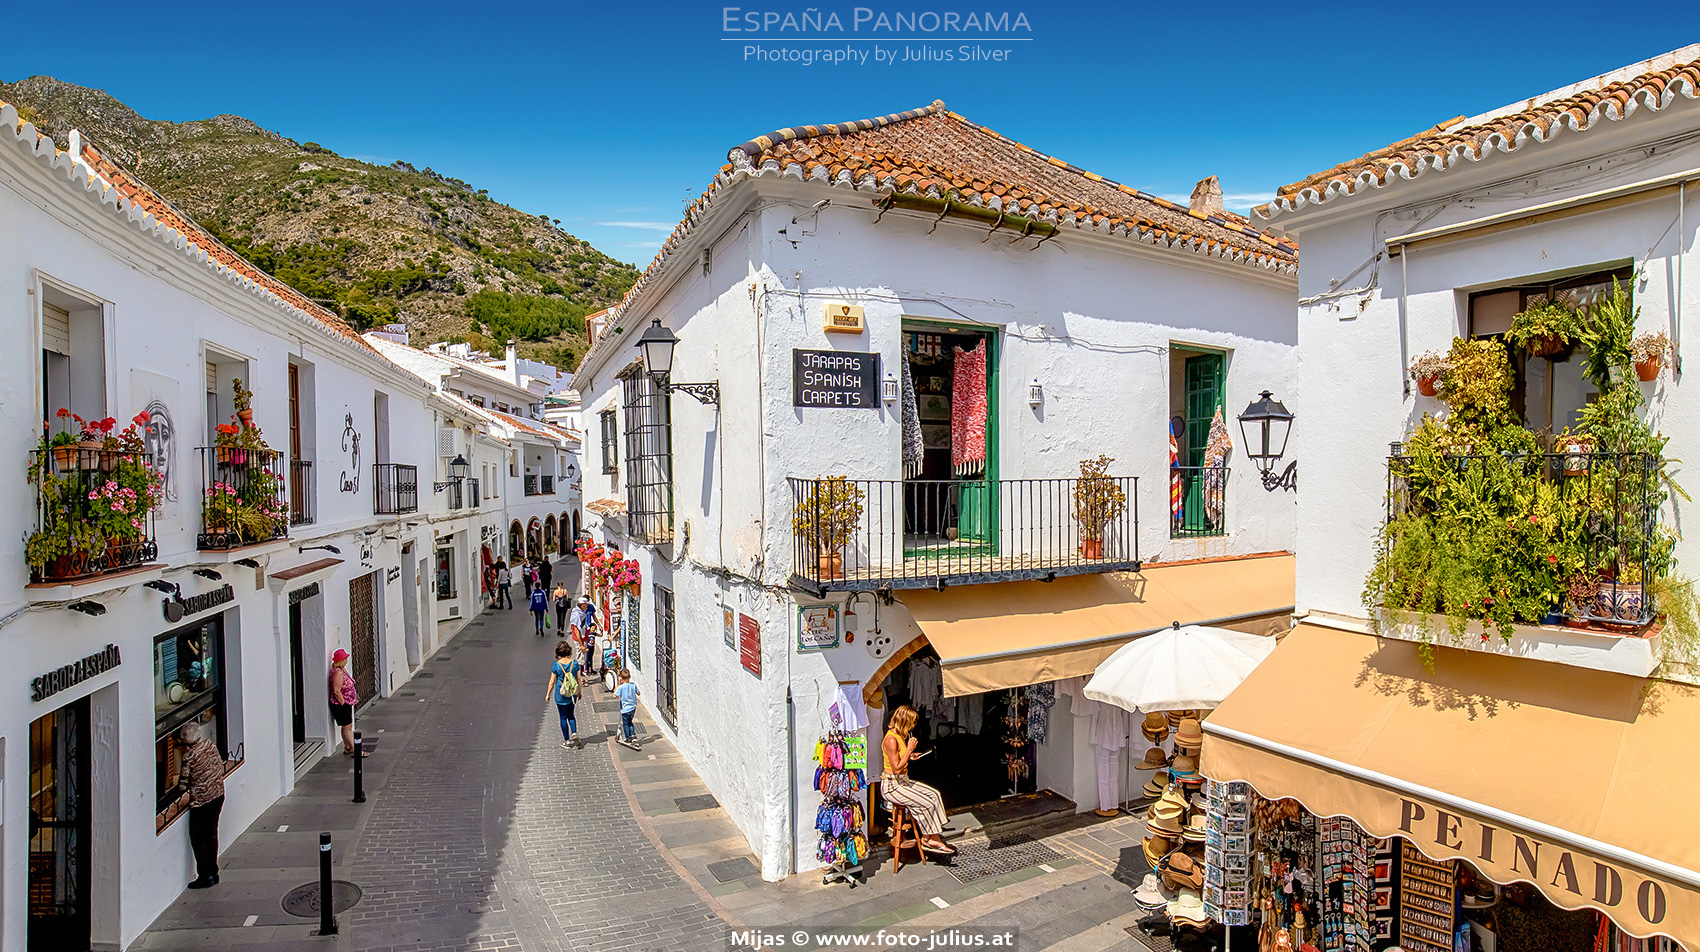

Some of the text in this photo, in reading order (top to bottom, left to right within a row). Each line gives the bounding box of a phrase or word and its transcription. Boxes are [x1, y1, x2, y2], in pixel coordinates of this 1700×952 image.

[802, 353, 861, 371] JARAPAS
[802, 389, 861, 405] CARPETS
[31, 643, 122, 702] SABOR A ESPAÑA
[1398, 797, 1667, 925] PEINADO
